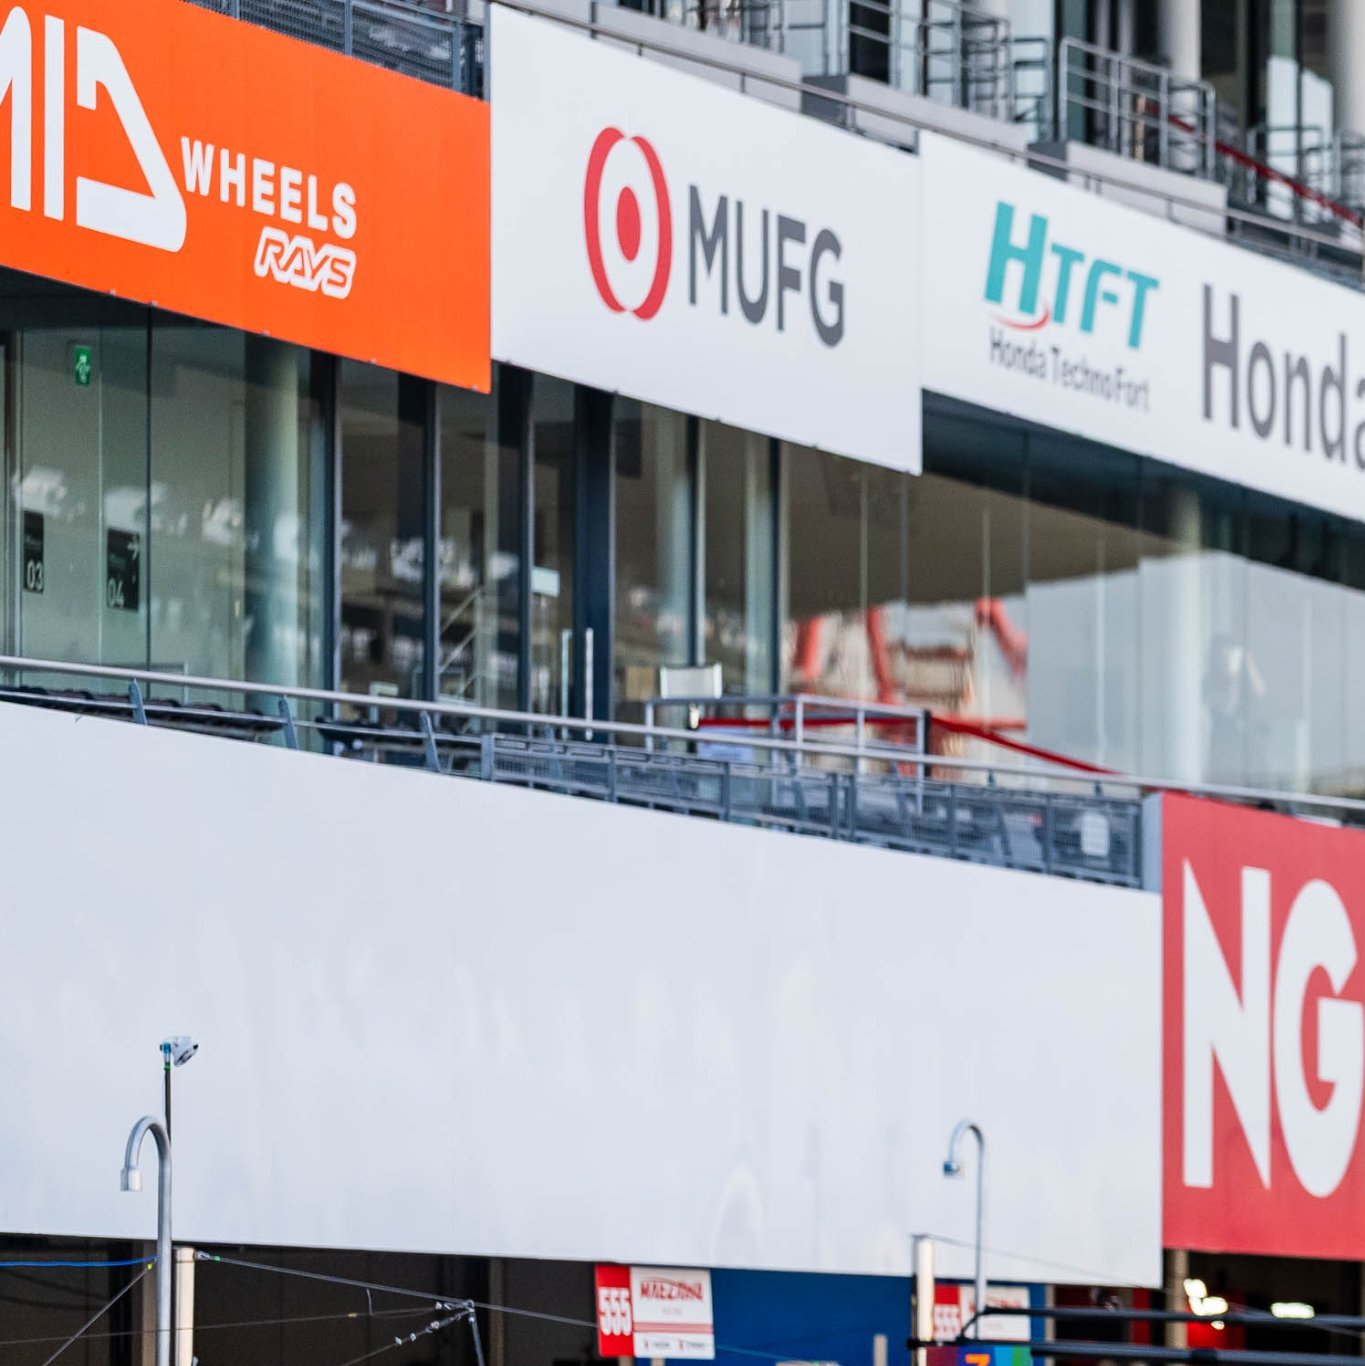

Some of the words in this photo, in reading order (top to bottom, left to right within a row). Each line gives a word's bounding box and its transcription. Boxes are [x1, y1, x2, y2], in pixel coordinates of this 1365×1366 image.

[180, 135, 357, 239] WHEELS
[254, 226, 357, 299] RAYS
[688, 184, 845, 347] MUFG
[985, 201, 1160, 350] HTFT
